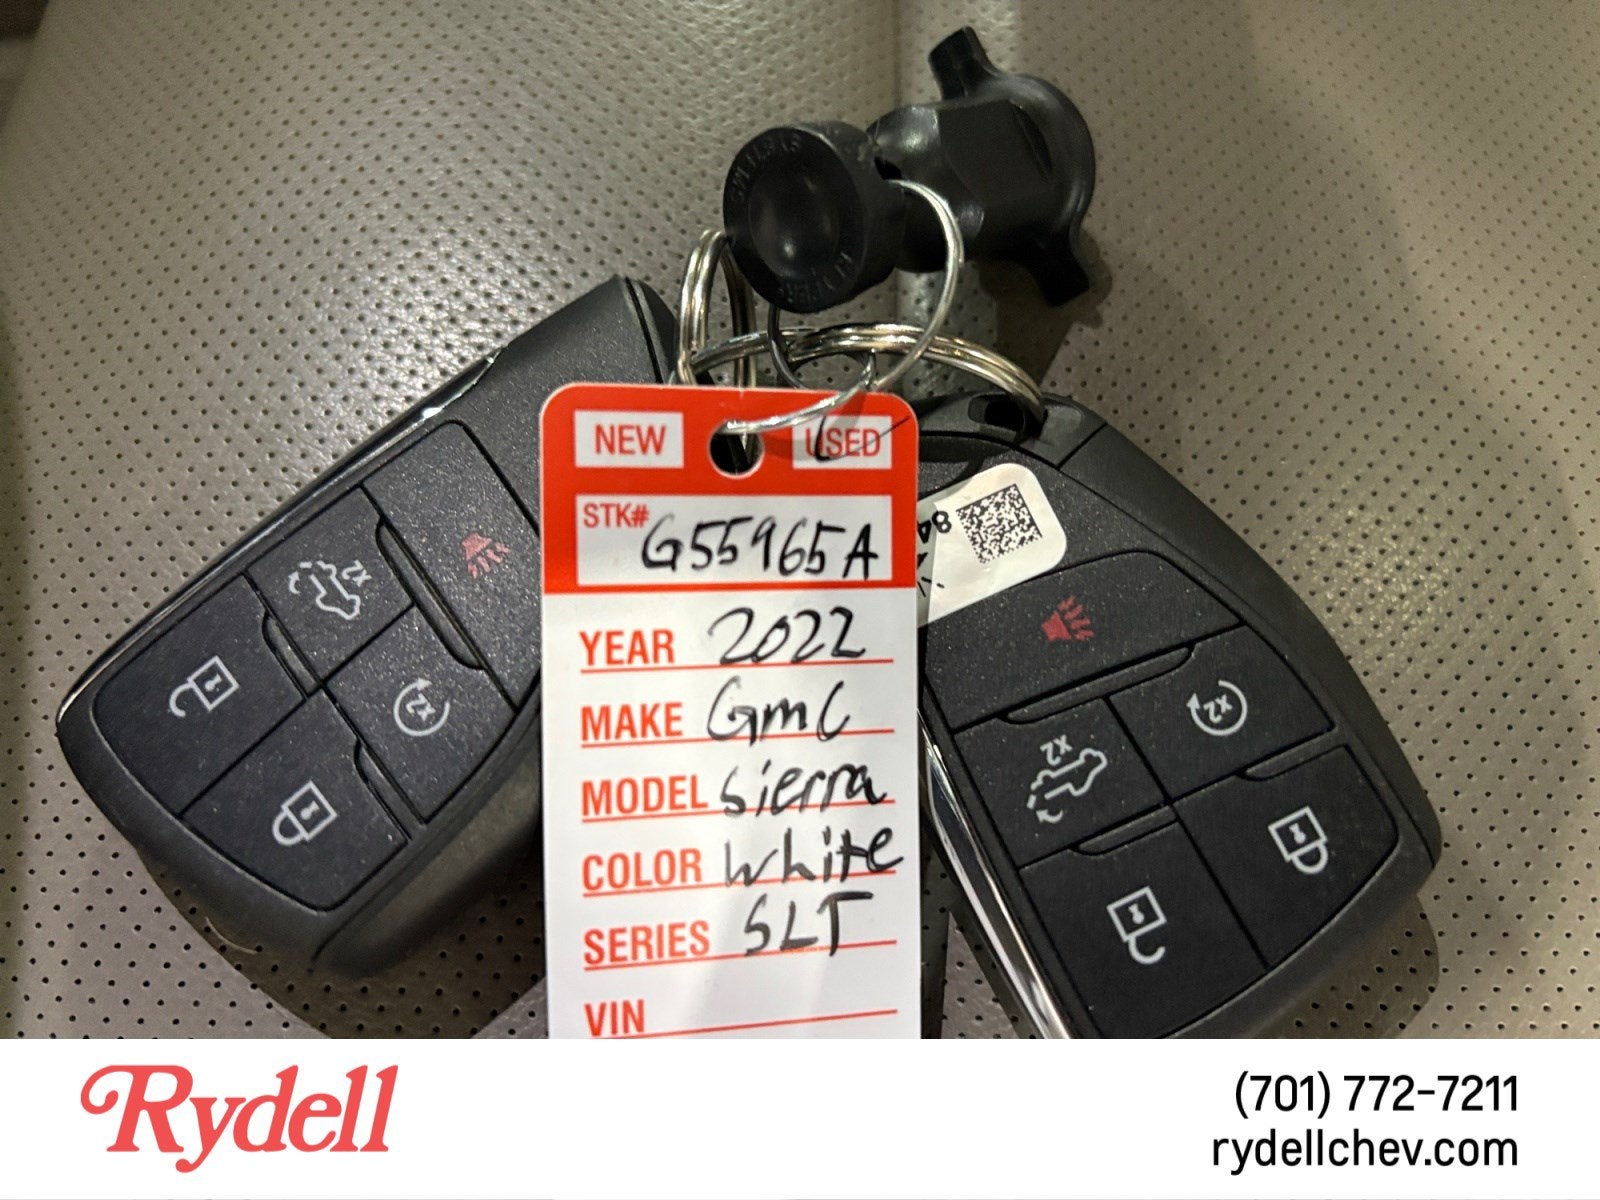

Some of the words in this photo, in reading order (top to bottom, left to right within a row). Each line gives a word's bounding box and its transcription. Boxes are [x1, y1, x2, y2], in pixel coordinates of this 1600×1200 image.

[594, 424, 667, 456] NEW
[805, 427, 881, 458] USED
[583, 503, 650, 528] STK#
[641, 514, 878, 580] G55965A
[579, 629, 675, 666] YEAR
[708, 606, 866, 665] 2022
[580, 702, 683, 741] MAKE
[582, 774, 708, 816] MODEL
[582, 848, 702, 891] COLOR
[583, 920, 711, 965] SERIES
[744, 891, 874, 957] SLT
[584, 999, 645, 1037] VIN
